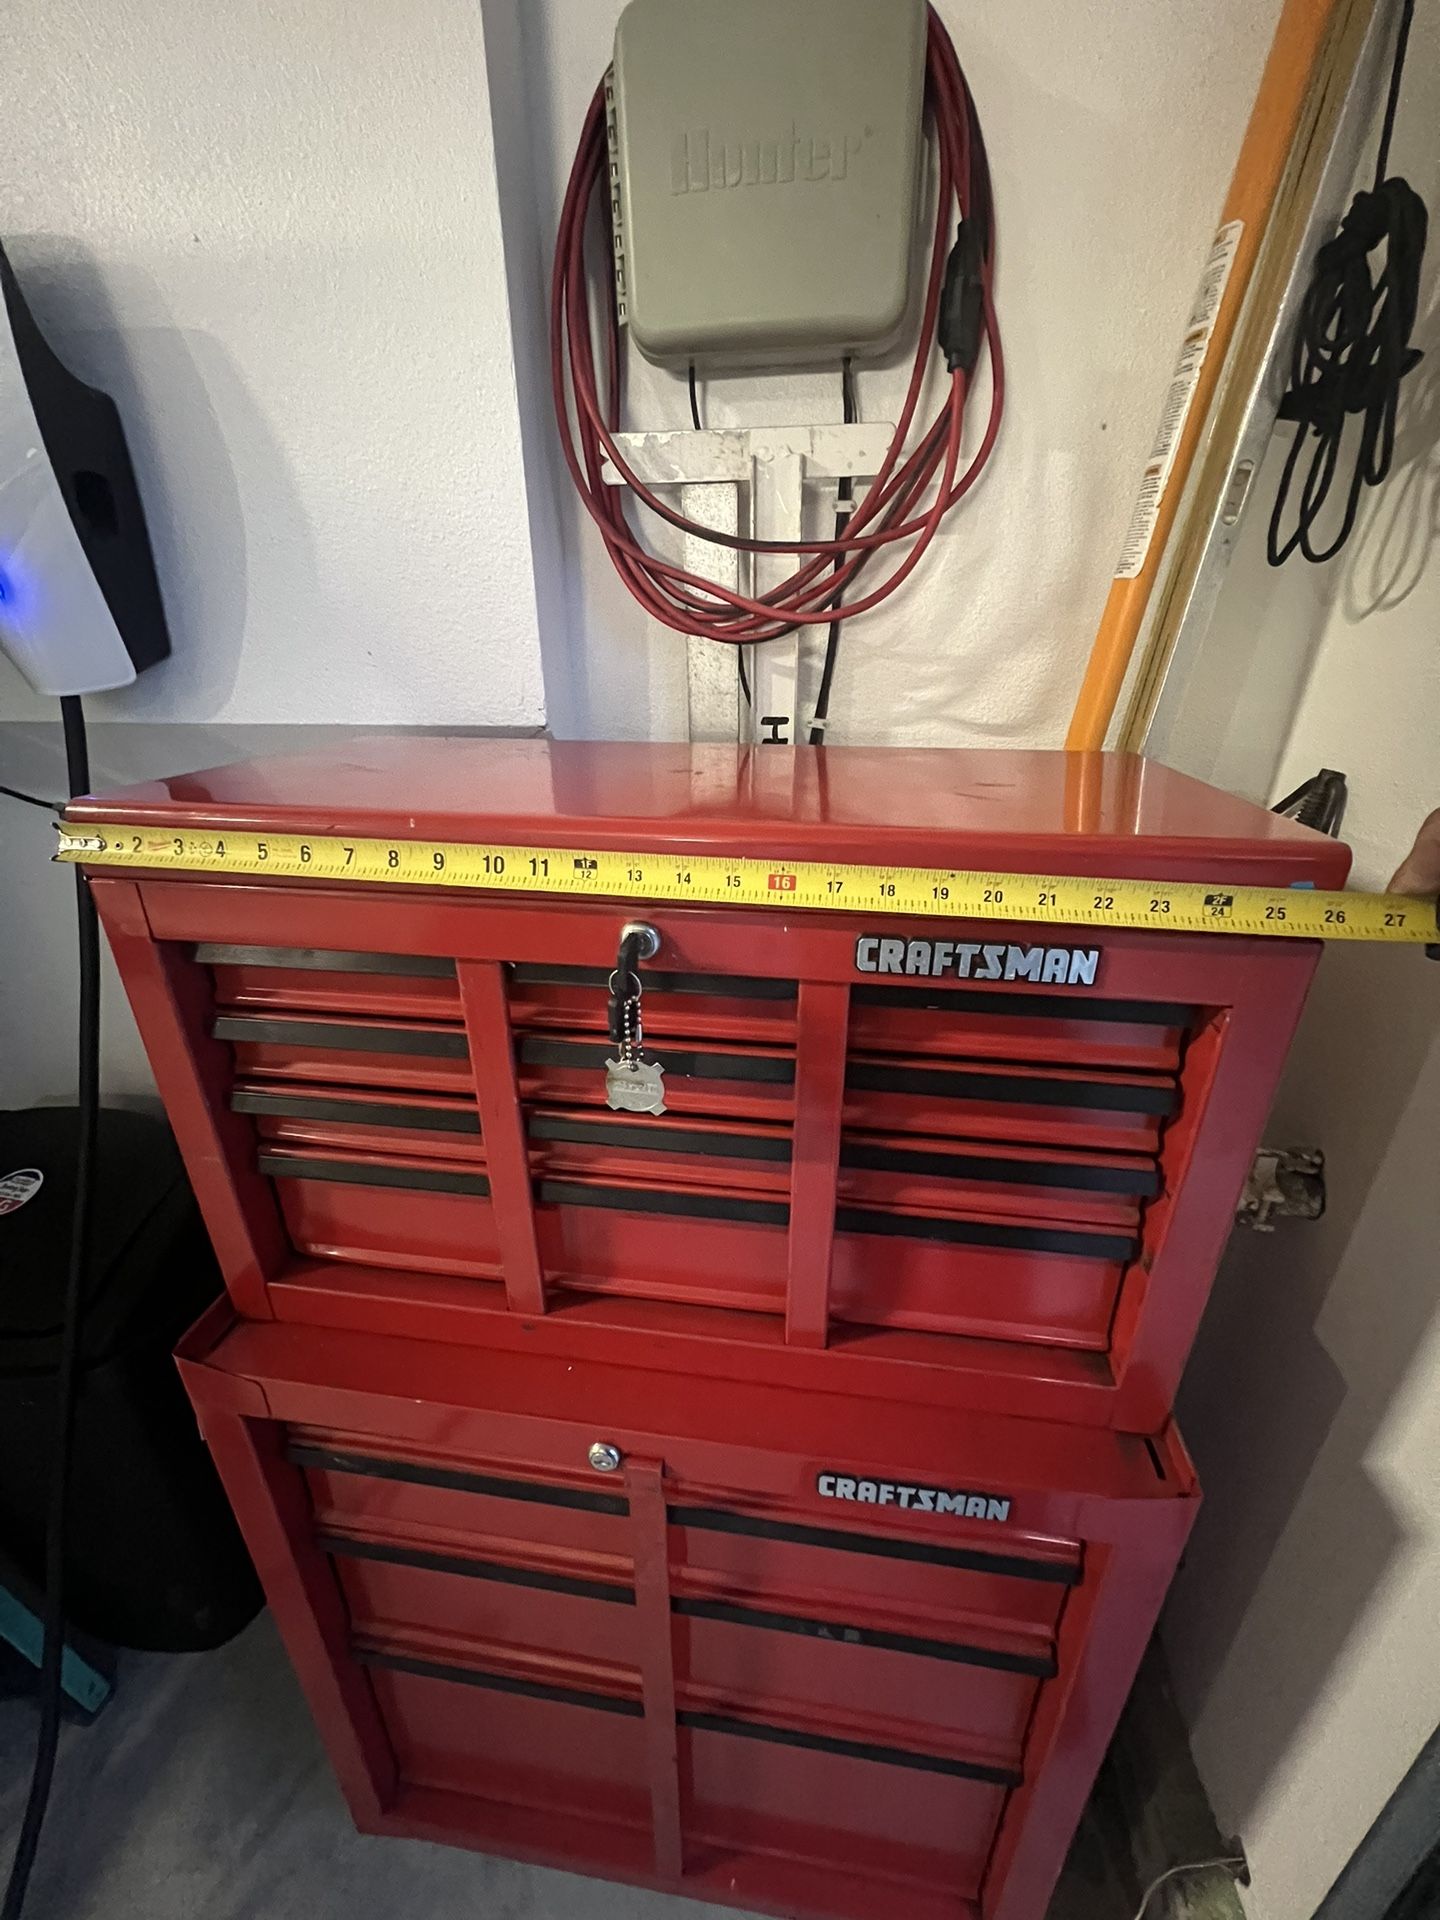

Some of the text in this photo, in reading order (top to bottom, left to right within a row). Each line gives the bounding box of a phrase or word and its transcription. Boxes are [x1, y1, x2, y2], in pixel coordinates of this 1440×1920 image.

[671, 121, 862, 196] Hunter
[132, 836, 1406, 927] 2 3 4 5 6 7 8 9 10 11 12 13 14 15 16 17 18 19 20 21 22 23 24 25 26 27
[1212, 895, 1227, 906] 2F
[856, 938, 1099, 985] CRAFTSMAN
[818, 1475, 1010, 1522] CRAFTSMAN
